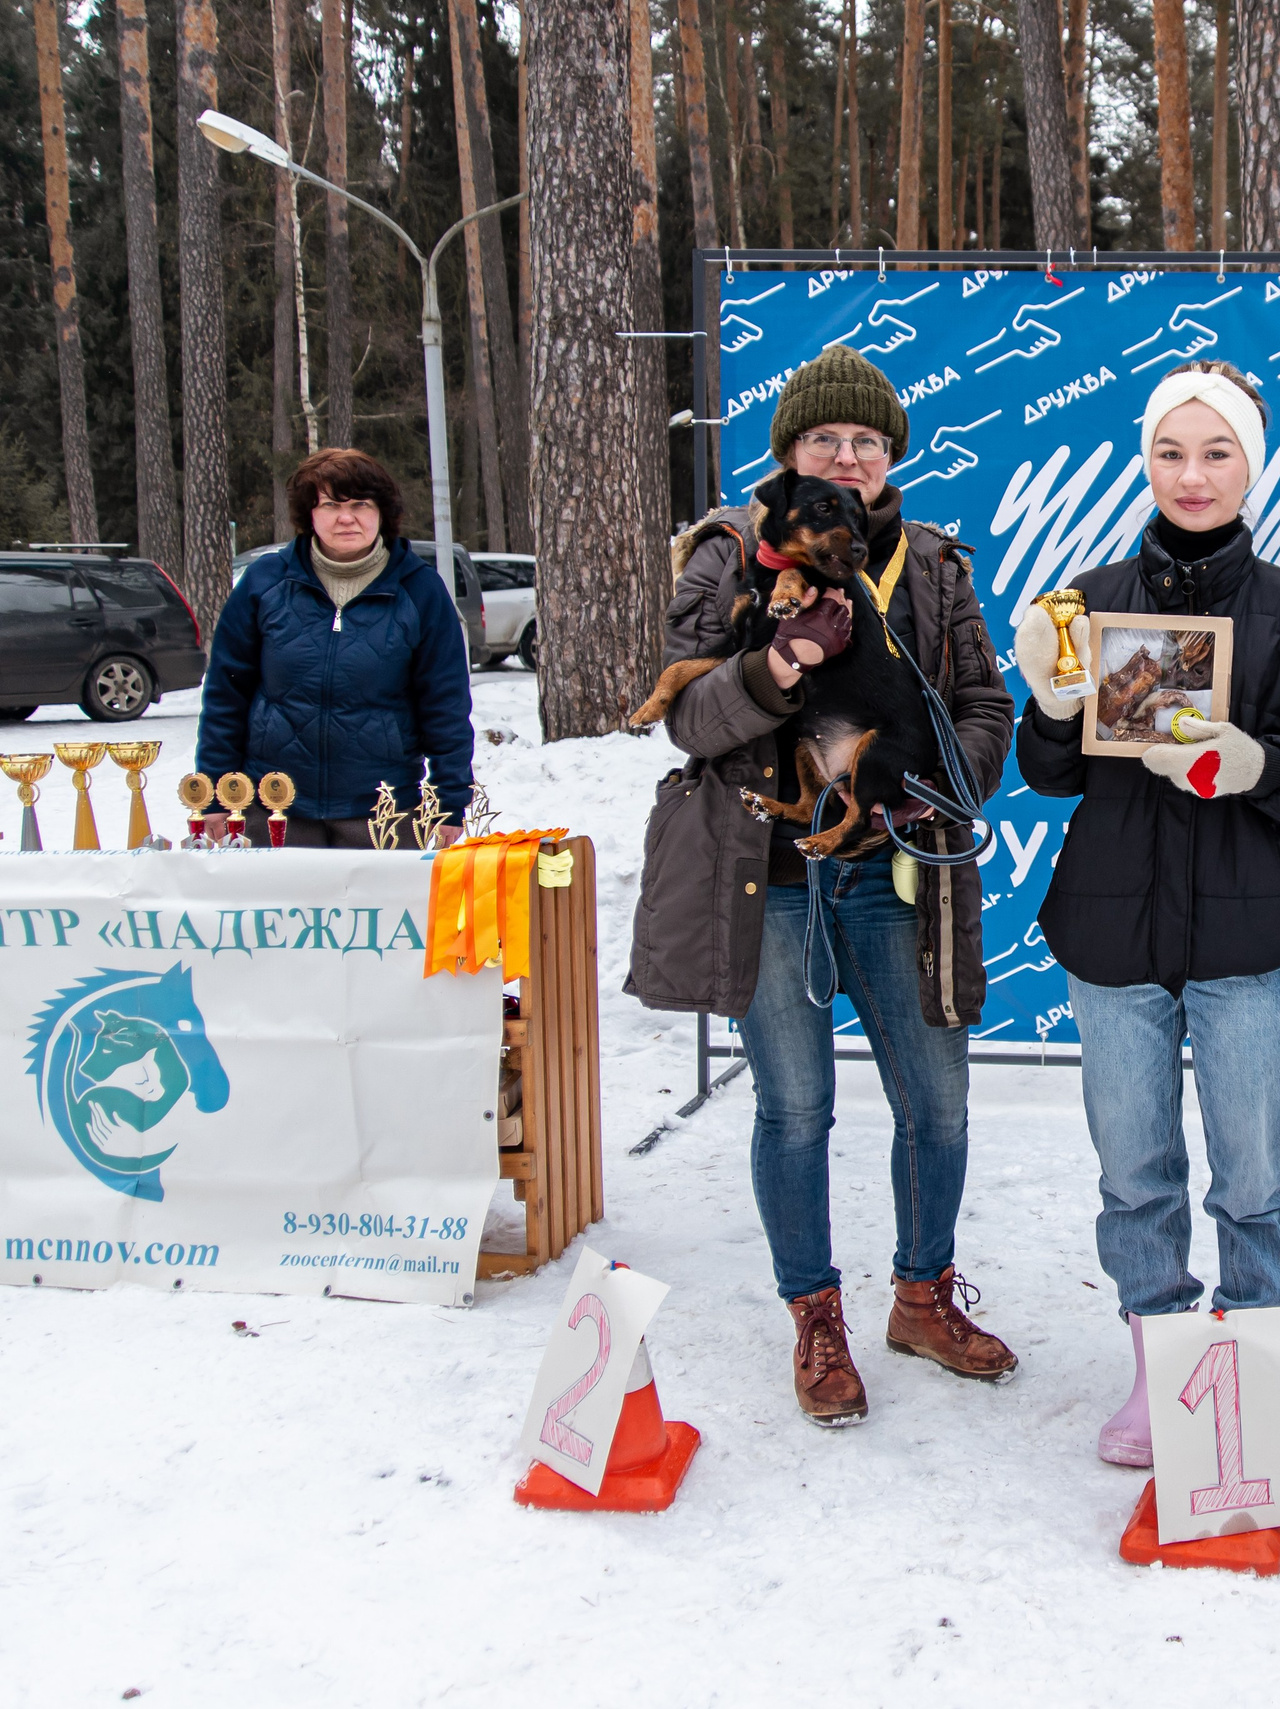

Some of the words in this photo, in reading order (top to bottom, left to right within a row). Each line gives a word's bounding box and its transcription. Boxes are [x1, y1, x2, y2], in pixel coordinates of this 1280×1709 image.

[807, 270, 855, 298] ДРУ
[961, 270, 1009, 298] ДРУ
[726, 360, 808, 418] ДРУЖ
[896, 365, 961, 408] УЖБА
[1024, 365, 1117, 425] ДРУЖБА
[1035, 1000, 1074, 1034] ДРУ
[283, 1211, 468, 1241] 8-930-804-31-88
[4, 1237, 220, 1267] mcnnov.com
[279, 1253, 460, 1276] zoocenternn@mail.ru
[539, 1293, 611, 1467] 2
[1177, 1340, 1274, 1516] 1
